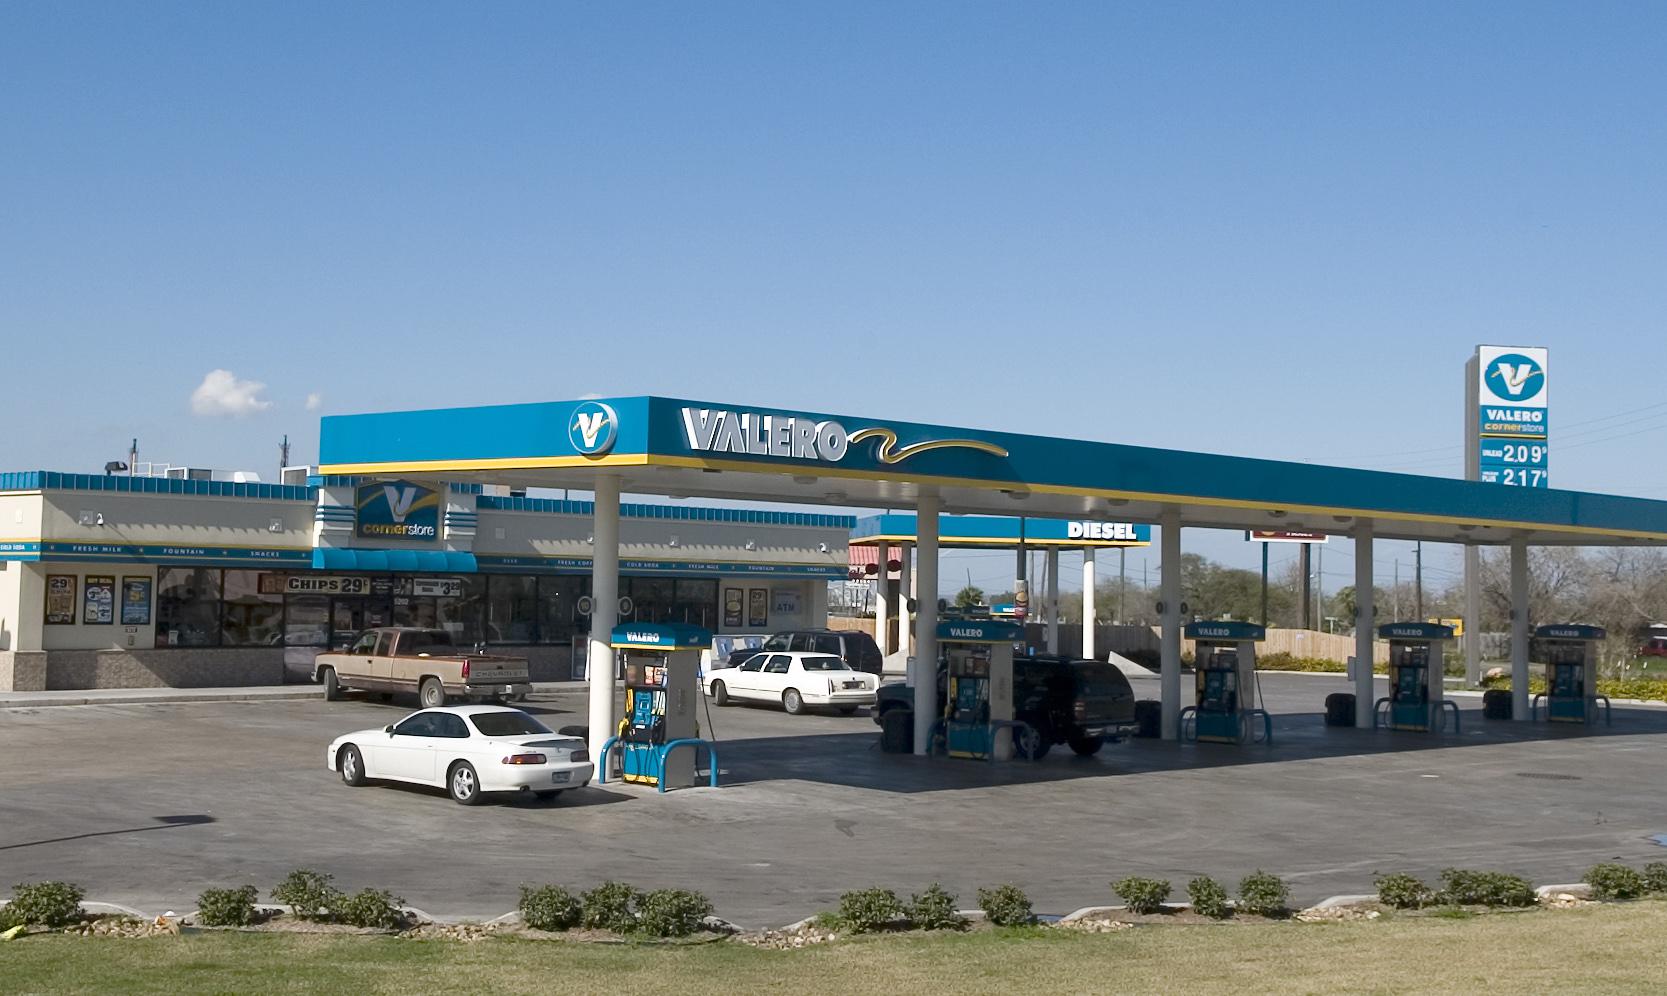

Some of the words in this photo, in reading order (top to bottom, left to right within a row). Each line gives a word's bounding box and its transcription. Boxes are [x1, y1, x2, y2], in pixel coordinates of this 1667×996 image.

[1486, 409, 1543, 422] VALERO
[681, 407, 848, 462] VALERO
[1068, 521, 1137, 540] DIESEL
[162, 547, 205, 555] FOUNTAIN
[288, 577, 339, 591] CHIPS
[777, 603, 794, 612] ATM
[626, 631, 660, 643] VALERO
[950, 627, 983, 638] VALERO
[1198, 627, 1230, 637] VALERO
[1392, 628, 1423, 636] VALERO
